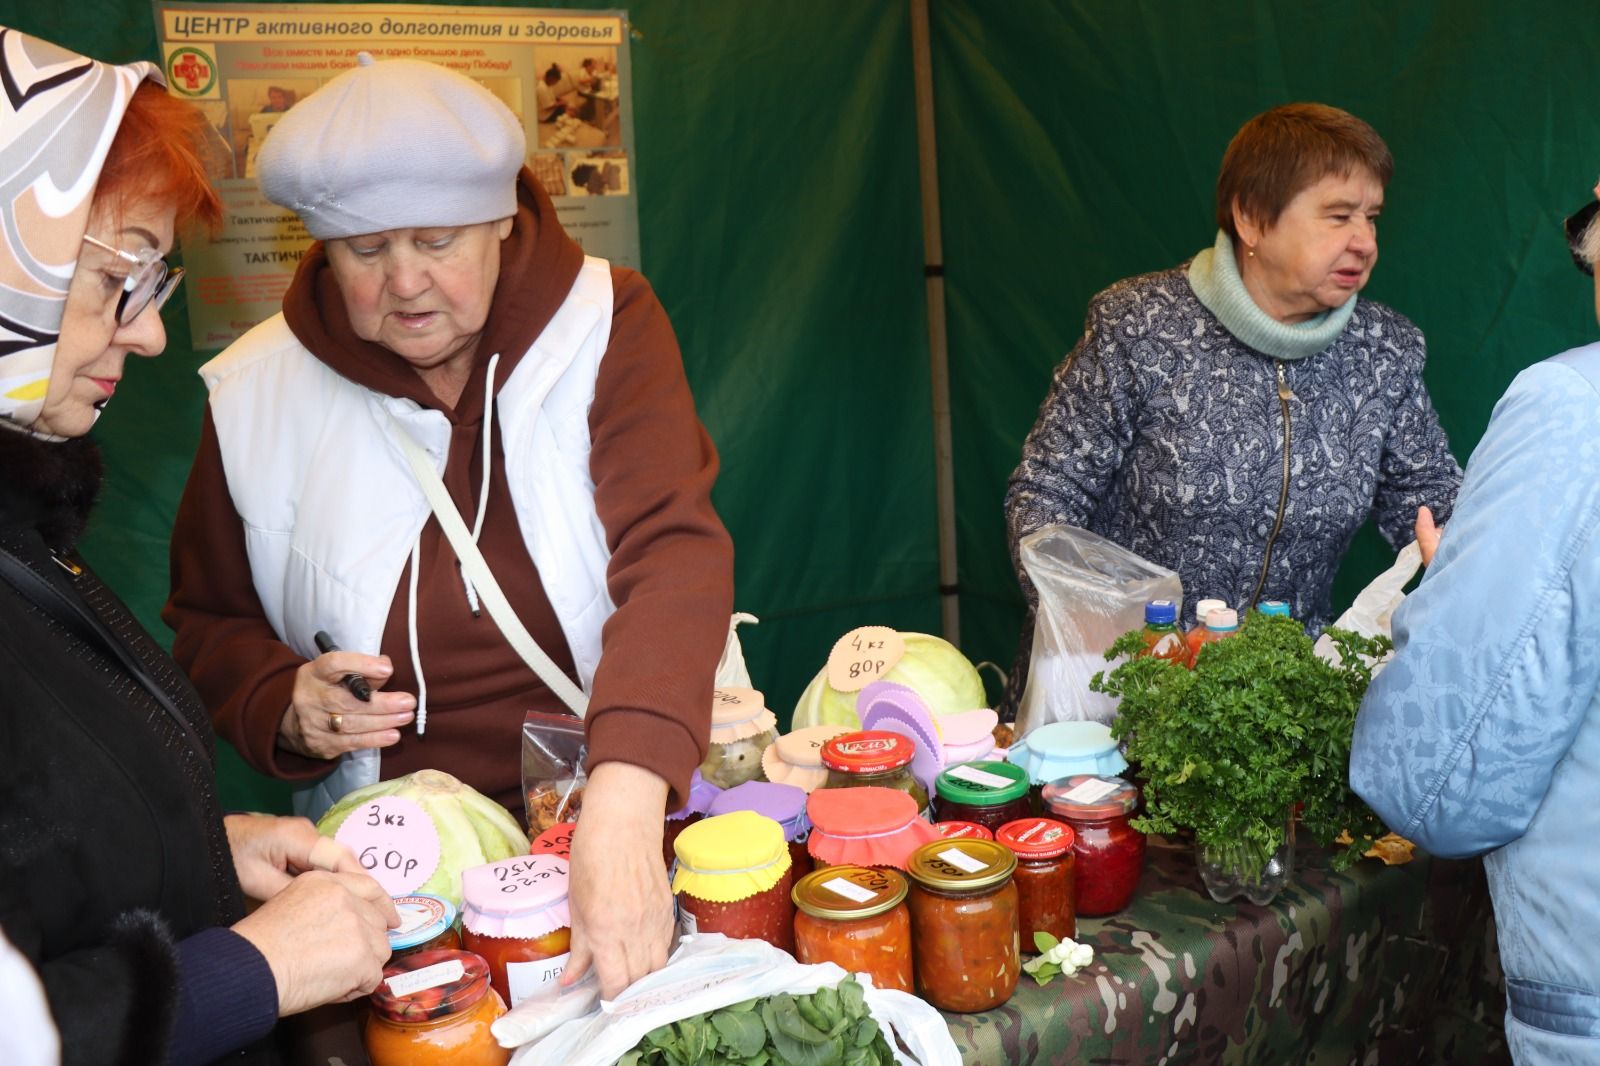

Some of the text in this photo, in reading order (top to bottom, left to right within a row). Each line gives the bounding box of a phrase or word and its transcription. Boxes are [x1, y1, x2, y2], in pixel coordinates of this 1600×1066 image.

[174, 16, 613, 40] ЦЕНТР активного долголетия и здоровья
